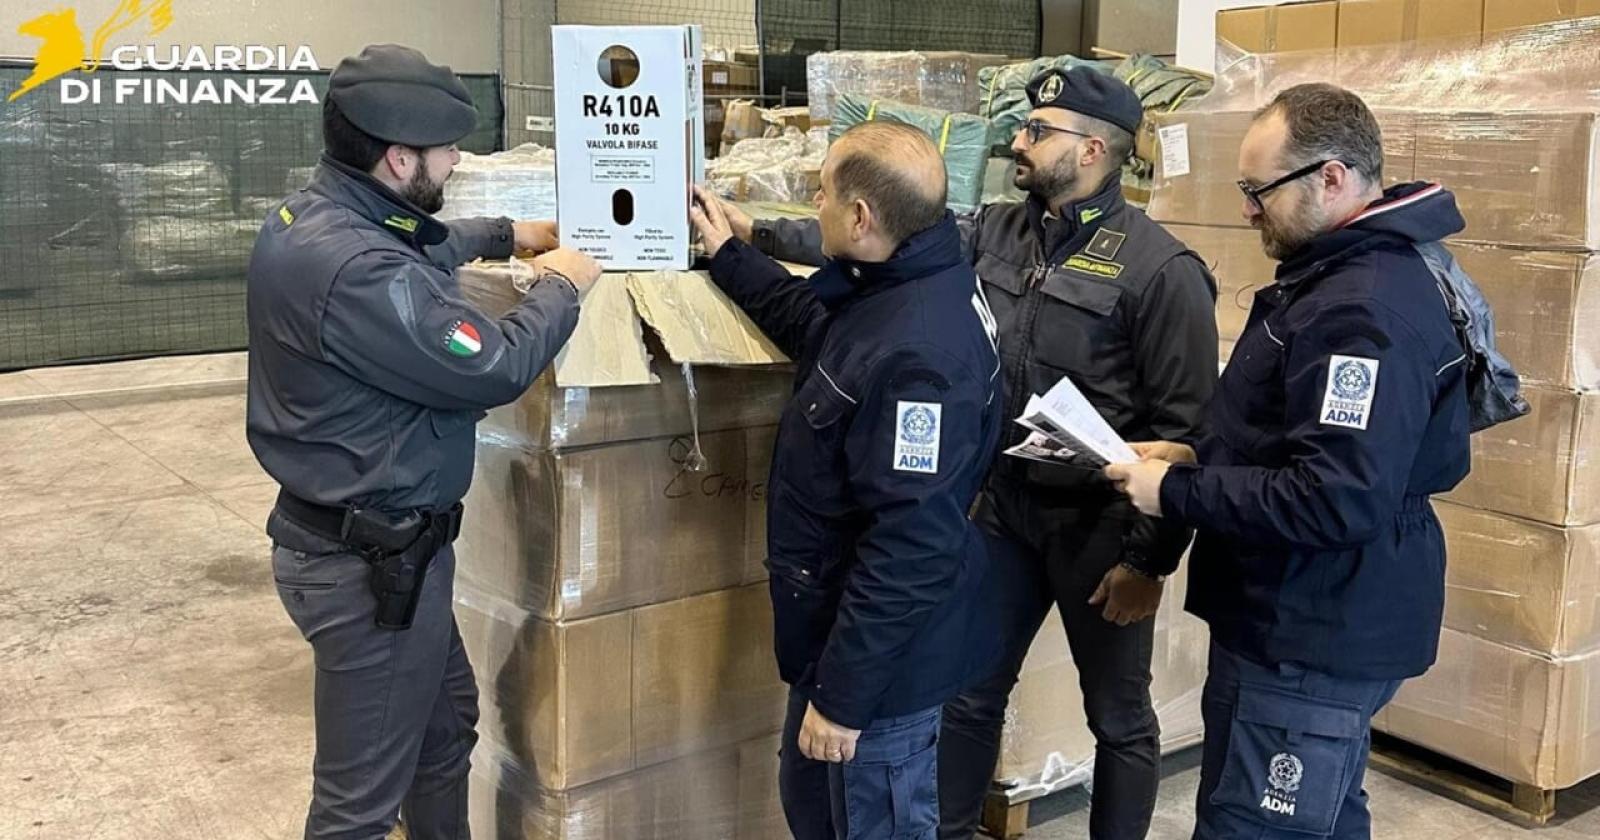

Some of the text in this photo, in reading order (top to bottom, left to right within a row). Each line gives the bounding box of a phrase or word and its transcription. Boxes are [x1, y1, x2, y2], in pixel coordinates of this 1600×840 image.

[583, 95, 660, 117] R410A
[605, 123, 640, 135] 10 KG
[586, 140, 658, 149] VALVOLA BIFASE
[1325, 409, 1362, 425] ADM
[898, 455, 933, 470] ADM
[1260, 795, 1295, 816] ADM
